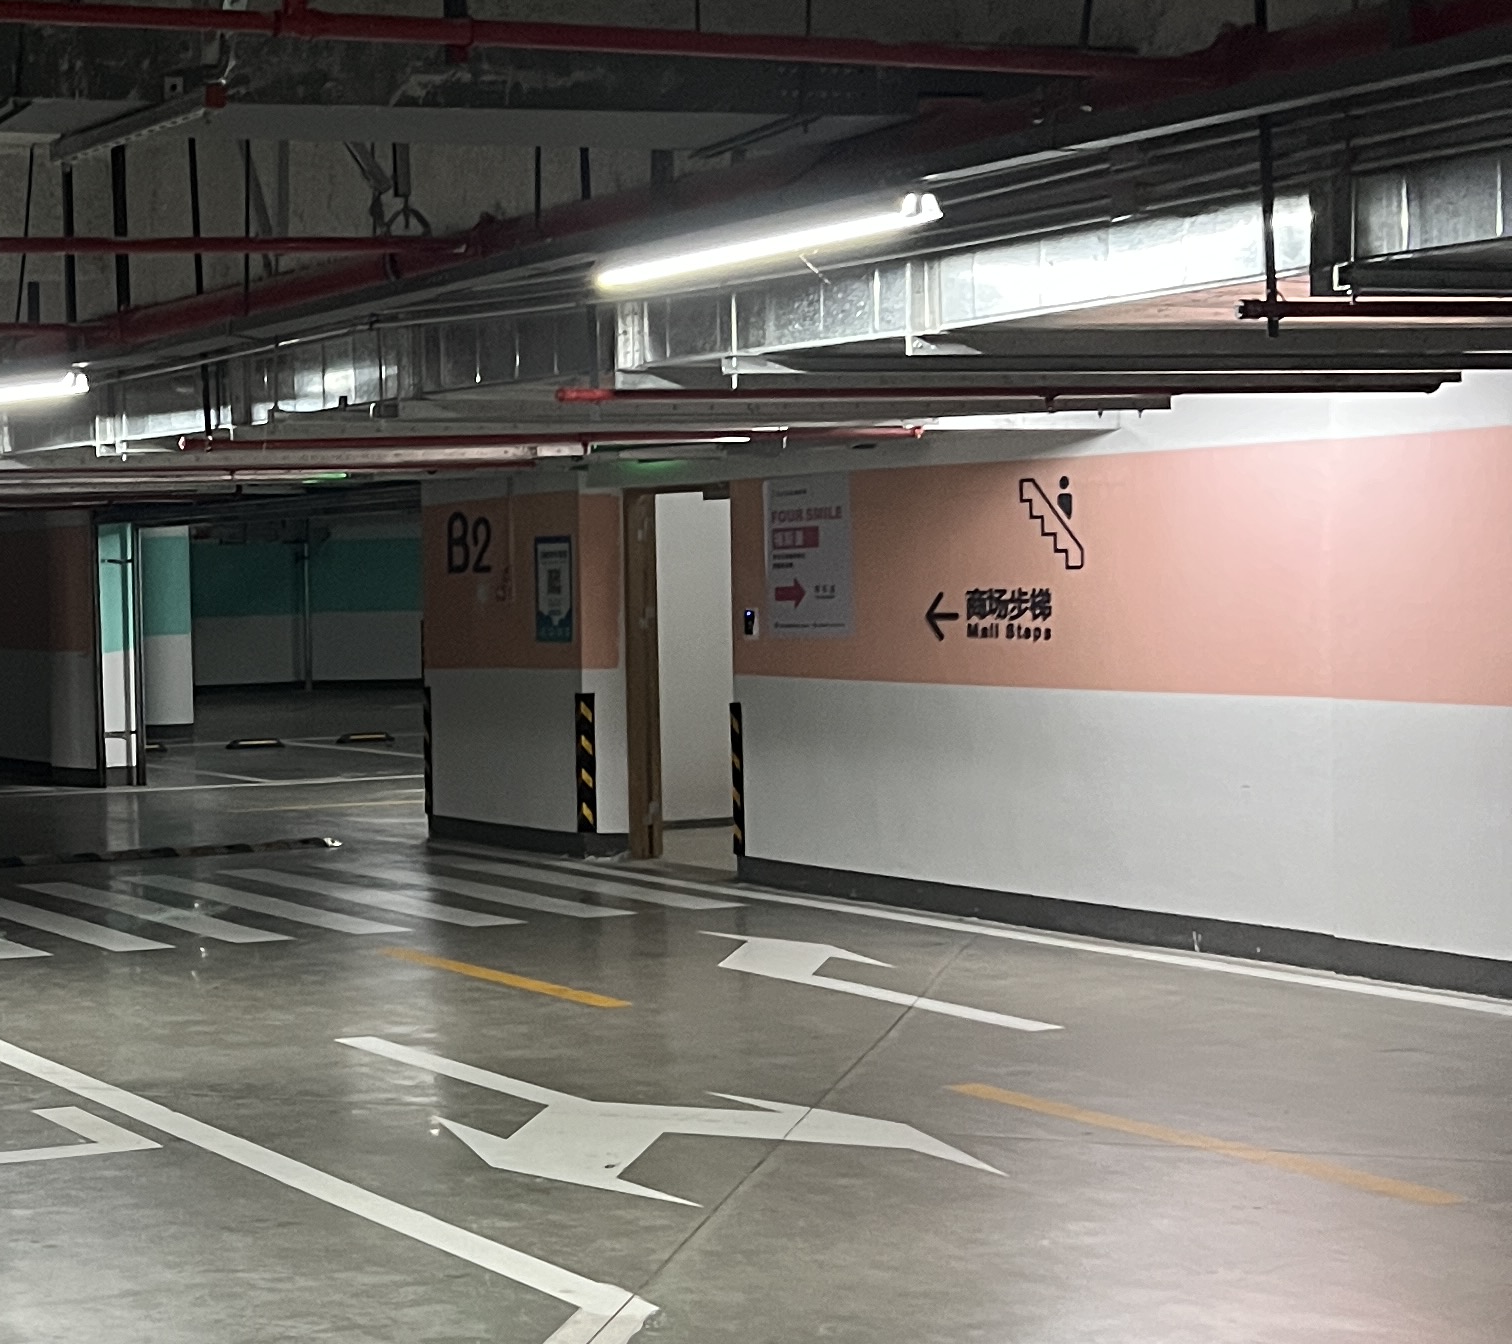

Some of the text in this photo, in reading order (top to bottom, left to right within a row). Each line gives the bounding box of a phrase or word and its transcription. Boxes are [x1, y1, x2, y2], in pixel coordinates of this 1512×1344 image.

[448, 511, 491, 573] B2
[966, 587, 1052, 622] 商场步梯
[966, 622, 1052, 643] Mall Steps
